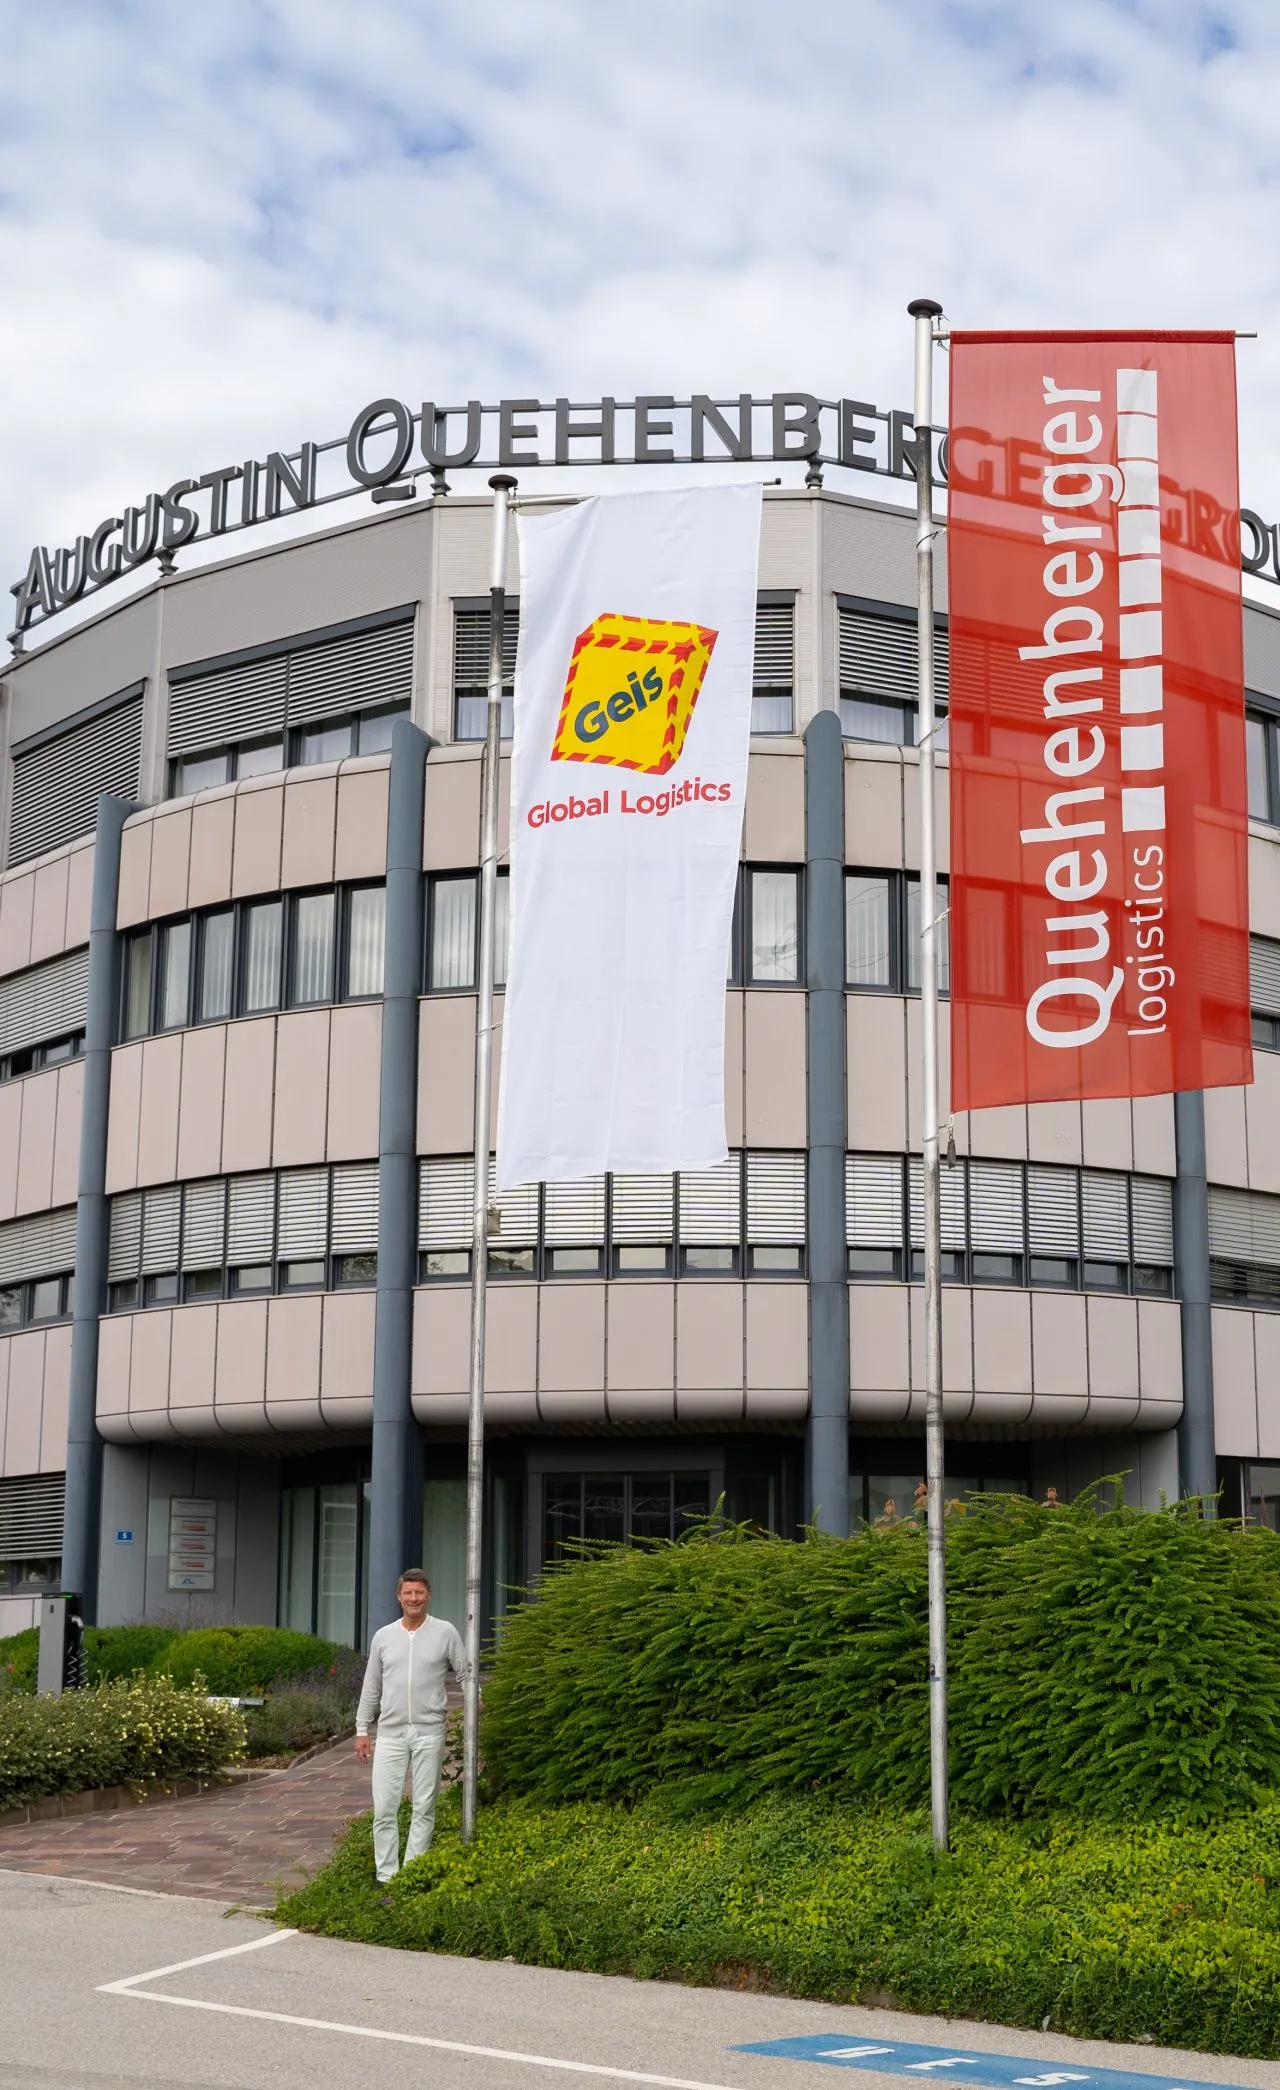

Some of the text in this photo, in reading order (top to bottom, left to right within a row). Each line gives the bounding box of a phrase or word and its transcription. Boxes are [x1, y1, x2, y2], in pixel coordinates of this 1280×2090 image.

[17, 441, 318, 630] AUGUSTIN
[574, 666, 663, 743] Geis
[1019, 375, 1125, 1048] Quehenberger
[527, 776, 731, 828] Global Logistics
[1124, 845, 1175, 1035] logistics
[816, 2045, 1190, 2090] BES
